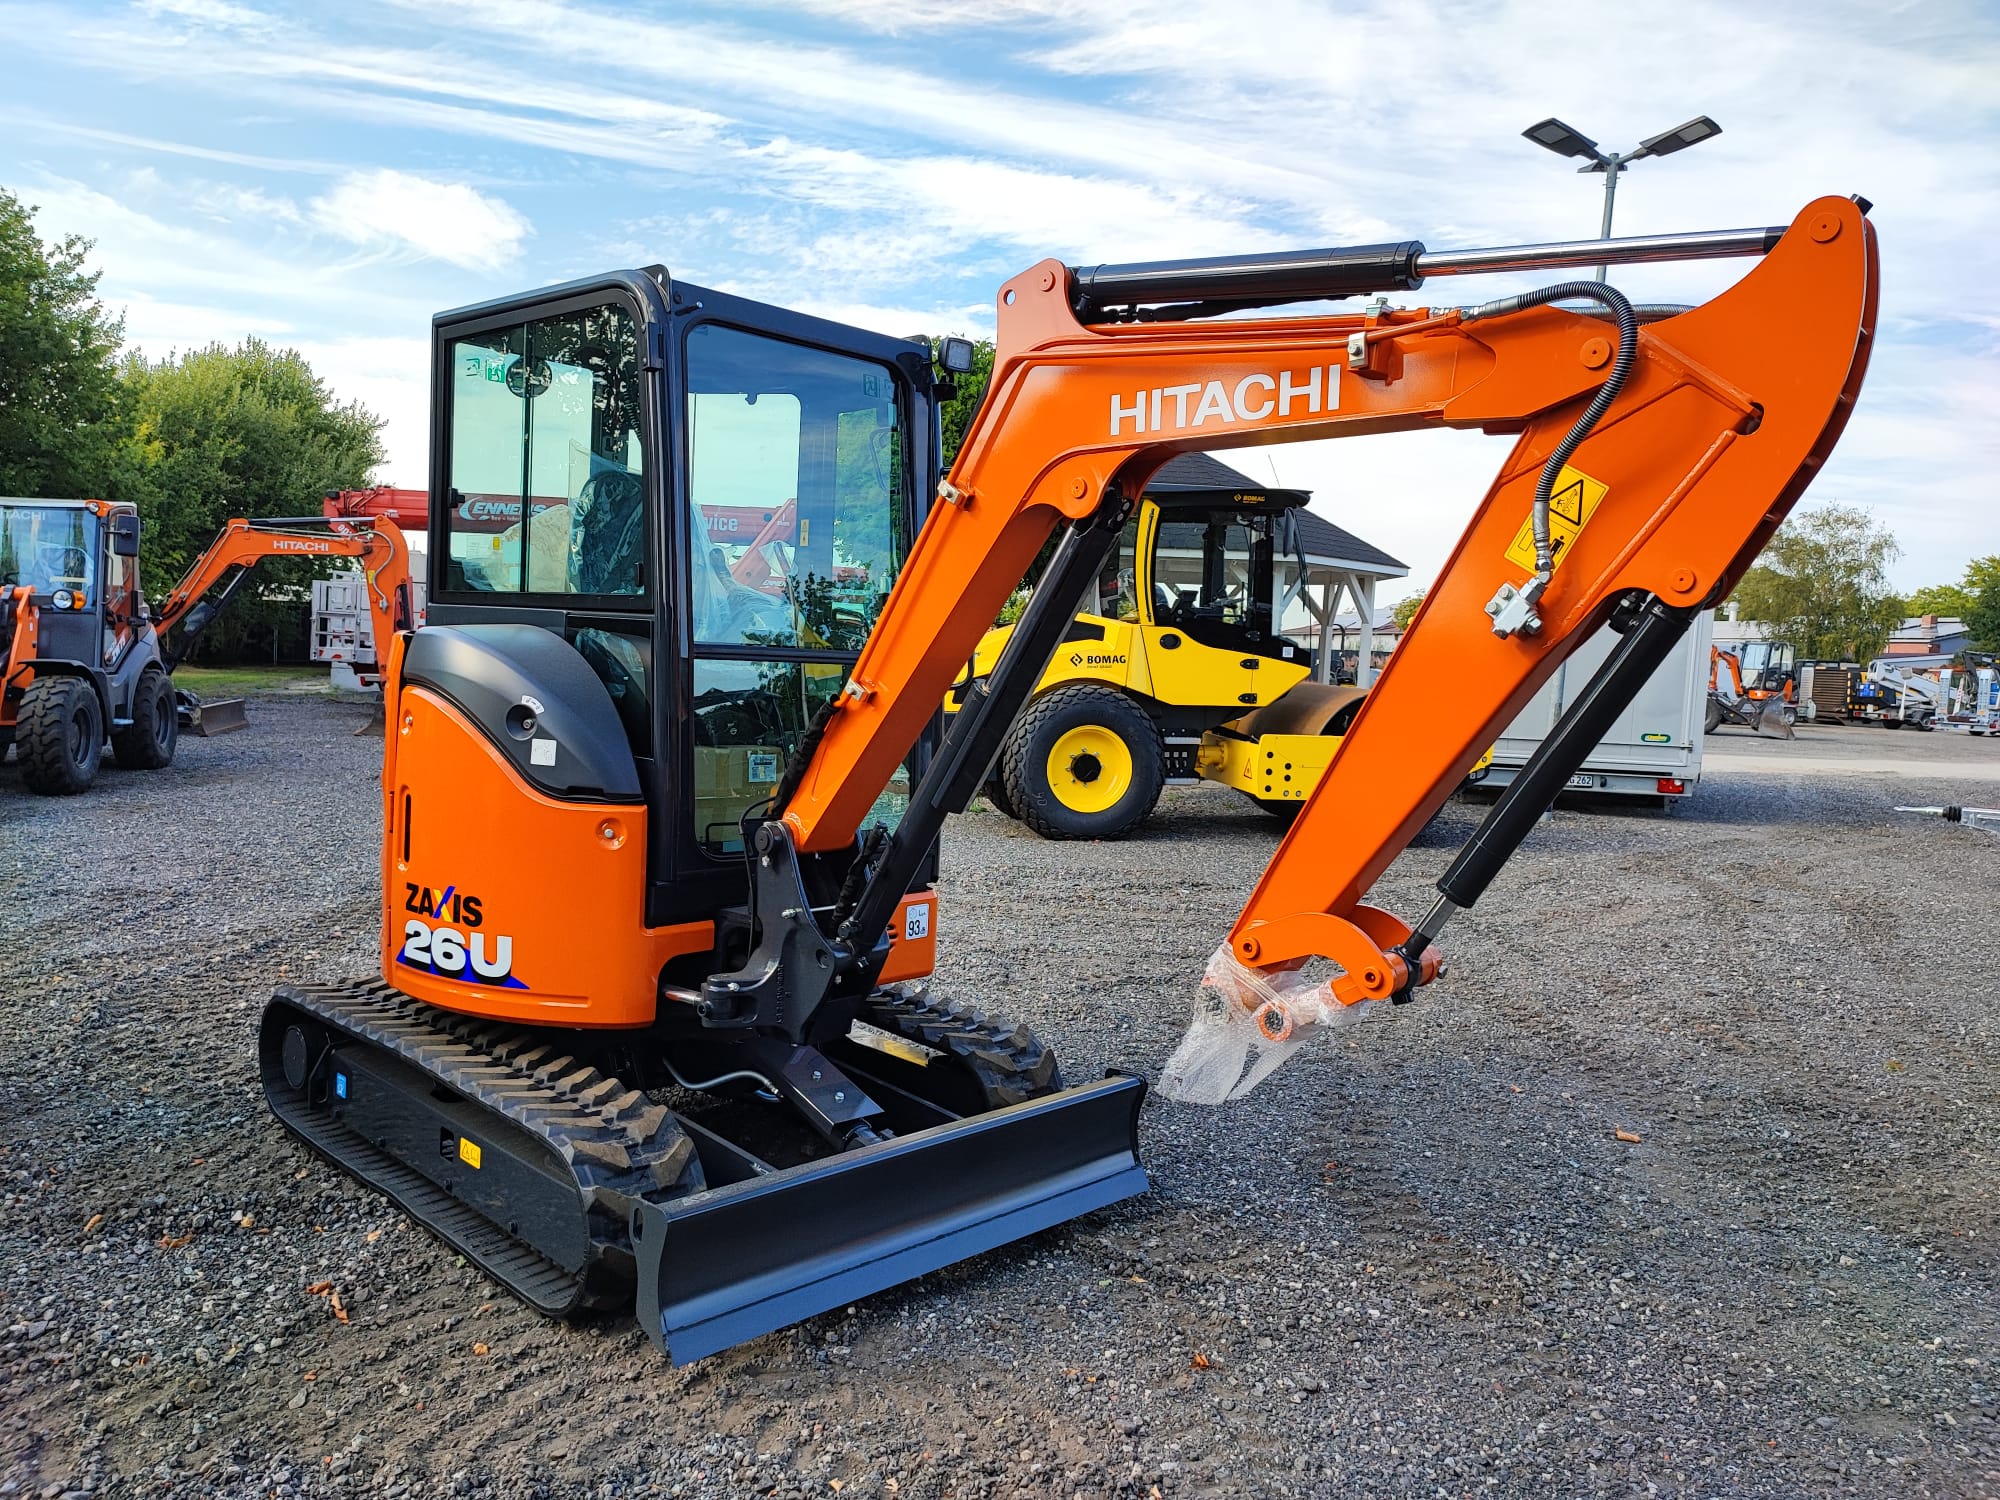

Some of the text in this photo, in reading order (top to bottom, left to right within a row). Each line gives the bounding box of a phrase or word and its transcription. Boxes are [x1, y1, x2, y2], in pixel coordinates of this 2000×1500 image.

[1110, 364, 1342, 436] HITACHI
[273, 540, 329, 552] HITACHI
[1087, 655, 1127, 664] BOMAG
[1576, 776, 1592, 785] 262
[405, 881, 483, 928] ZAXIS
[908, 920, 921, 937] 93
[404, 919, 513, 981] 26U
